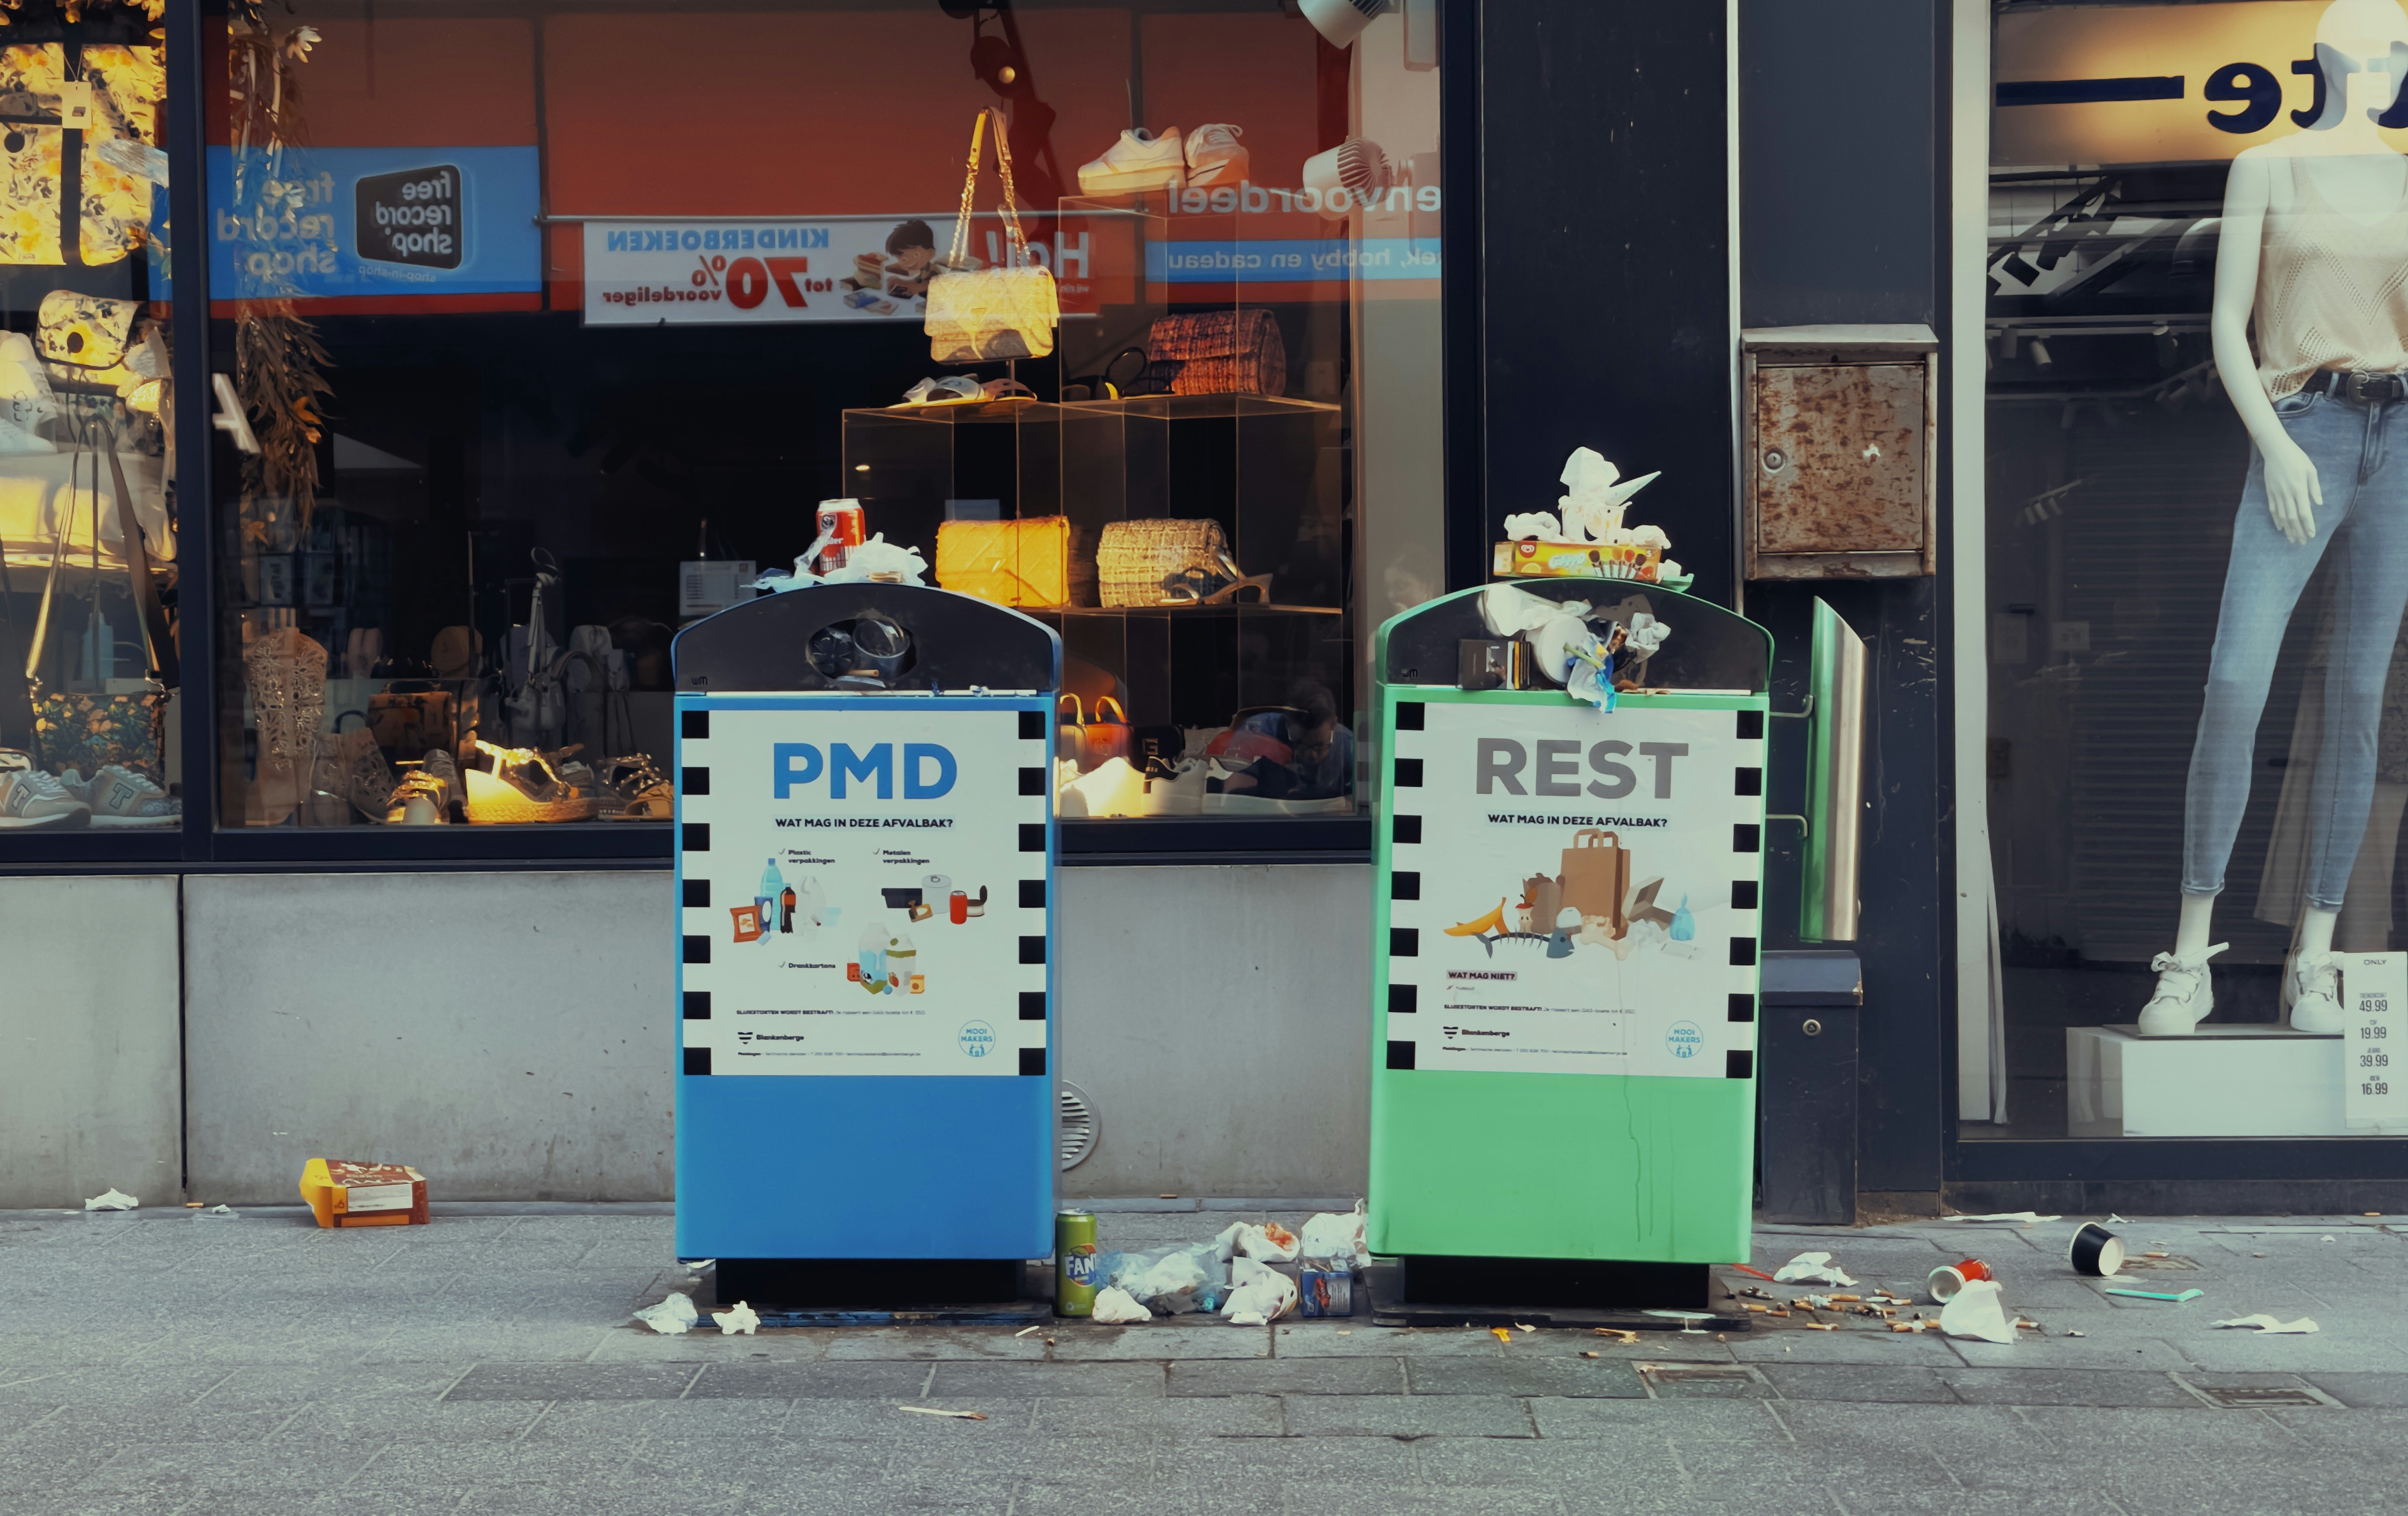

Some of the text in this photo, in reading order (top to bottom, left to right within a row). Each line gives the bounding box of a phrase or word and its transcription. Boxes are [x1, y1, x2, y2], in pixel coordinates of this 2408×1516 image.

[773, 743, 957, 799] PMD
[1476, 738, 1689, 799] REST
[775, 819, 953, 827] WAT MAG IN DEZE AFVALBAK?
[1488, 814, 1667, 827] WAT MAG IN DEZE AFVALBAK?
[2359, 1000, 2387, 1012] 49.99
[2360, 1026, 2387, 1039] 19.99
[2360, 1054, 2388, 1067] 39.99
[2362, 1082, 2388, 1095] 16.99
